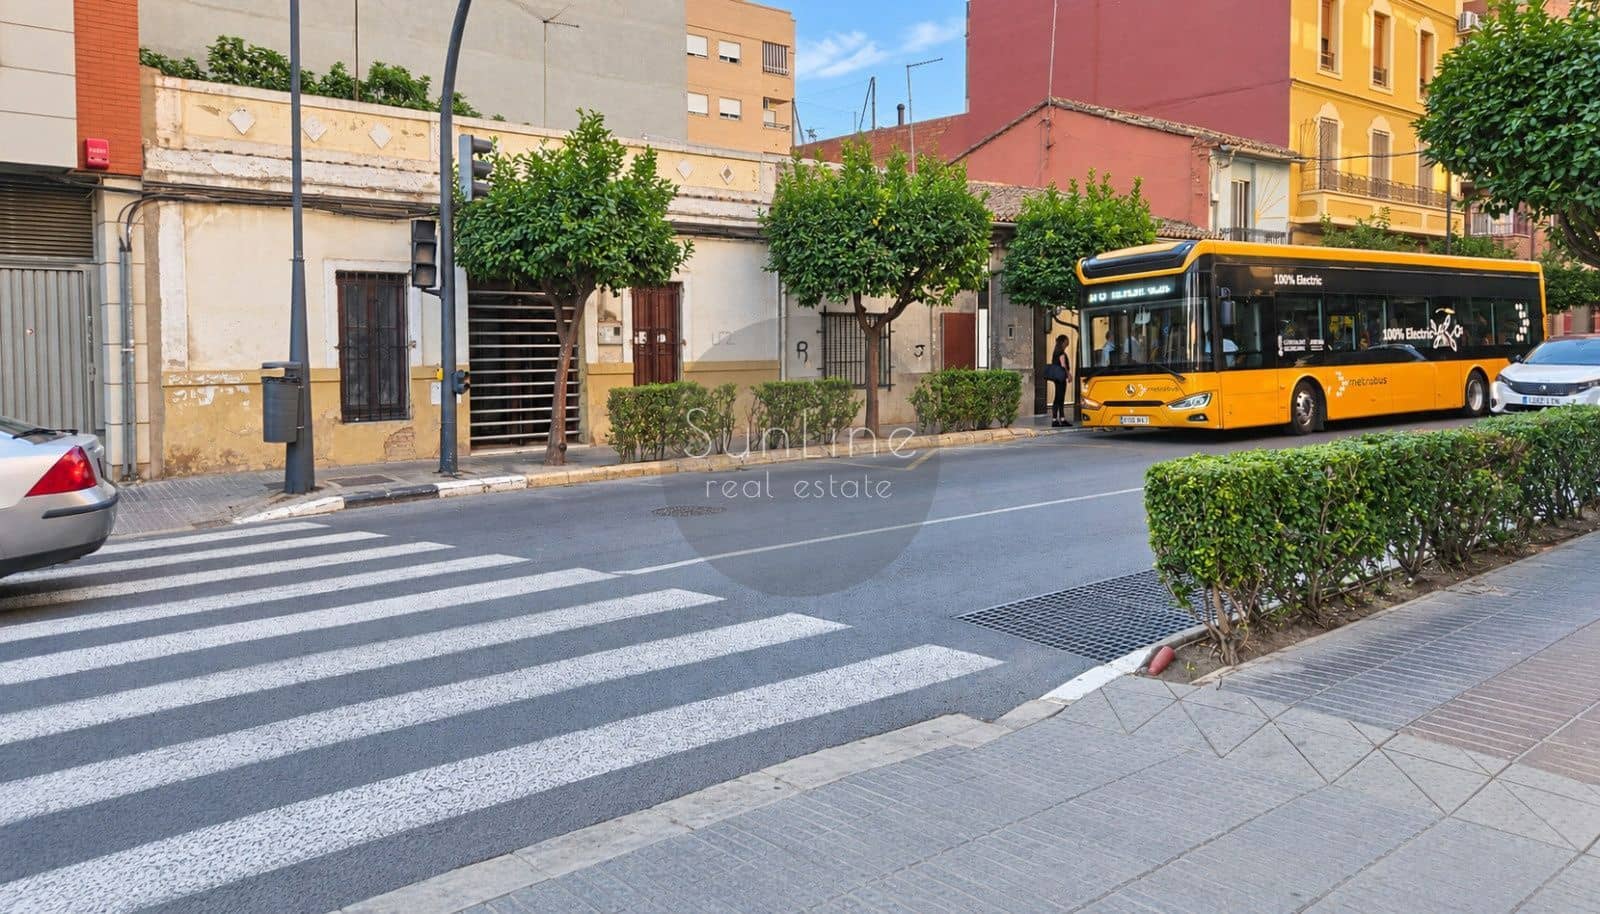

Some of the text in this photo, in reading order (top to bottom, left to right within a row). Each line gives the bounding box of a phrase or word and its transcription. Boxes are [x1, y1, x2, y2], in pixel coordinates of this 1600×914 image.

[1274, 274, 1322, 286] 100% Electric
[1383, 327, 1433, 340] 100% Electric
[1349, 376, 1387, 386] metrobus
